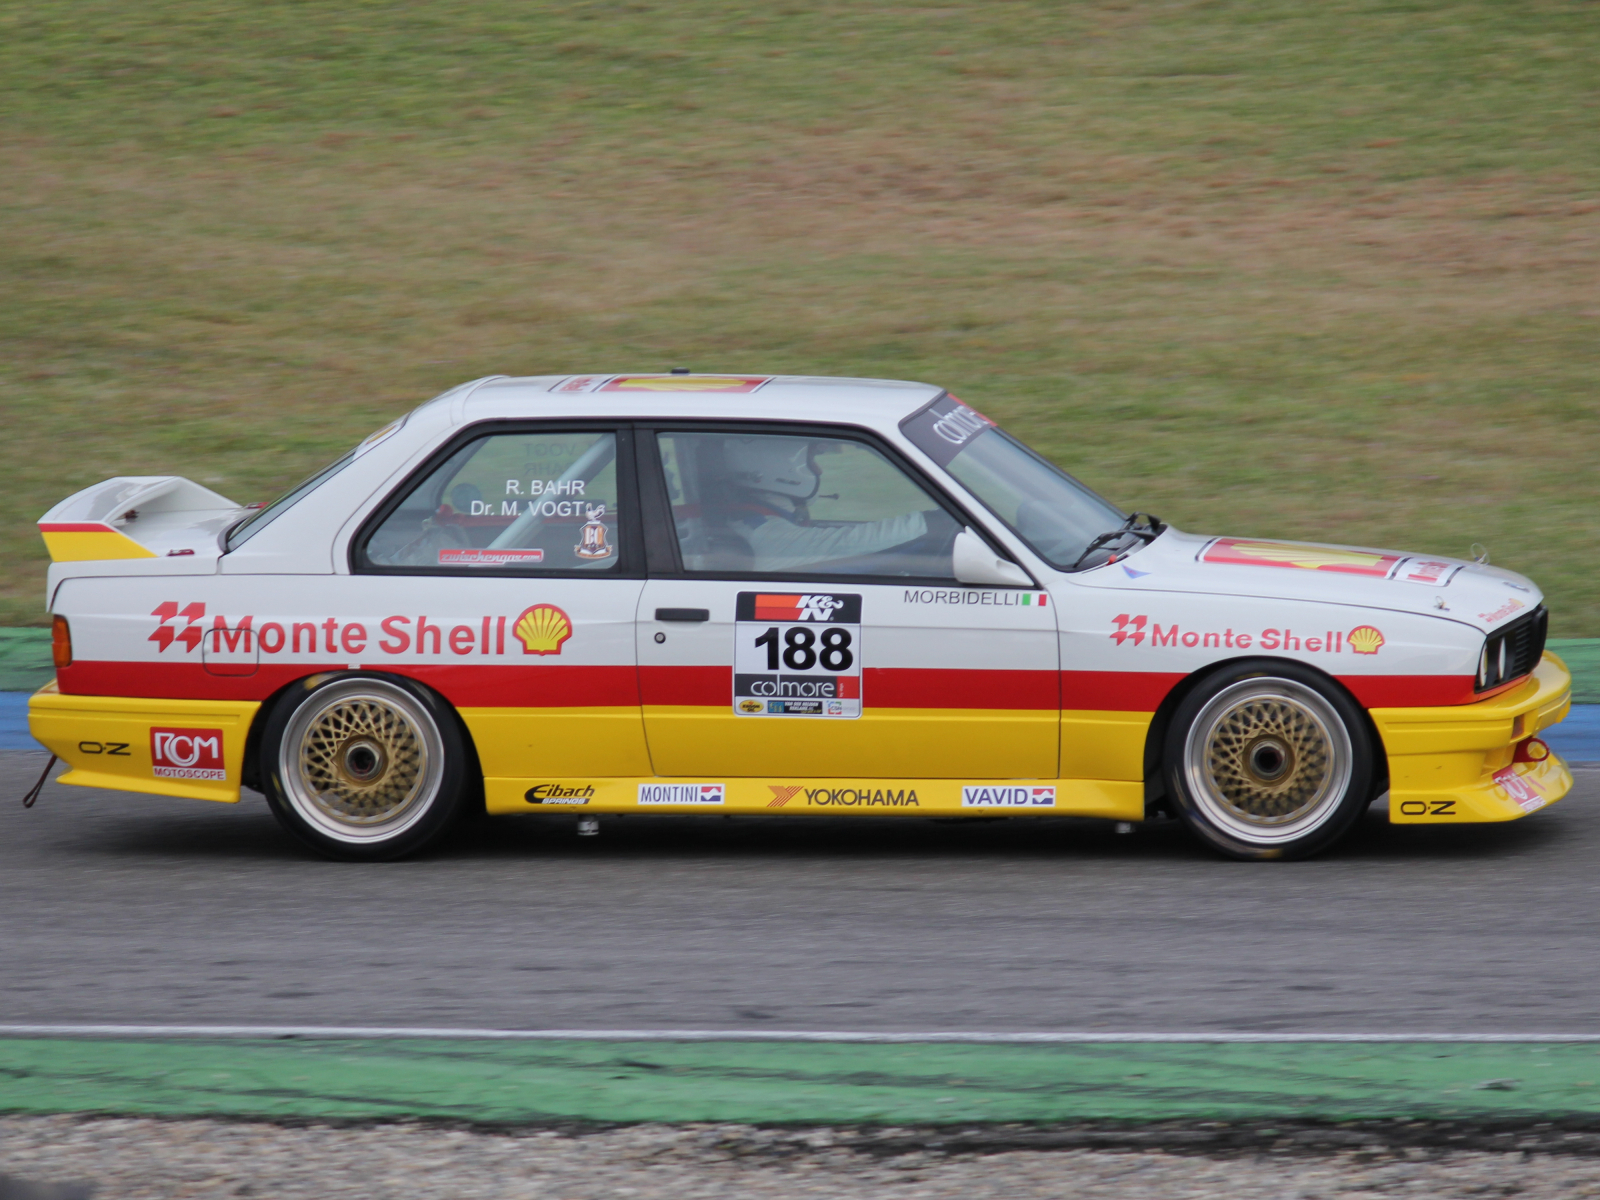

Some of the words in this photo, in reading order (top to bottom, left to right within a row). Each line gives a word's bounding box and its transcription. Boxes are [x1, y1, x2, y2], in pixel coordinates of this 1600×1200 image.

[505, 480, 525, 495] R.
[531, 480, 586, 495] BAHR
[470, 500, 496, 516] Dr.
[501, 501, 522, 516] M.
[528, 501, 584, 517] VOGT
[904, 590, 1019, 606] MORBIDELLI
[795, 594, 844, 621] K&N
[212, 615, 368, 655] Monte
[379, 615, 506, 655] Shell
[1151, 623, 1253, 649] Monte
[1259, 628, 1342, 653] Shell
[754, 626, 854, 671] 188
[750, 674, 835, 697] colmore
[154, 766, 224, 780] MOTOSCOPE
[524, 784, 596, 804] Eibach
[541, 797, 587, 805] SPRINGS
[640, 786, 699, 803] MONTINI
[804, 788, 919, 807] YOKOHAMA
[964, 788, 1028, 805] VAVID
